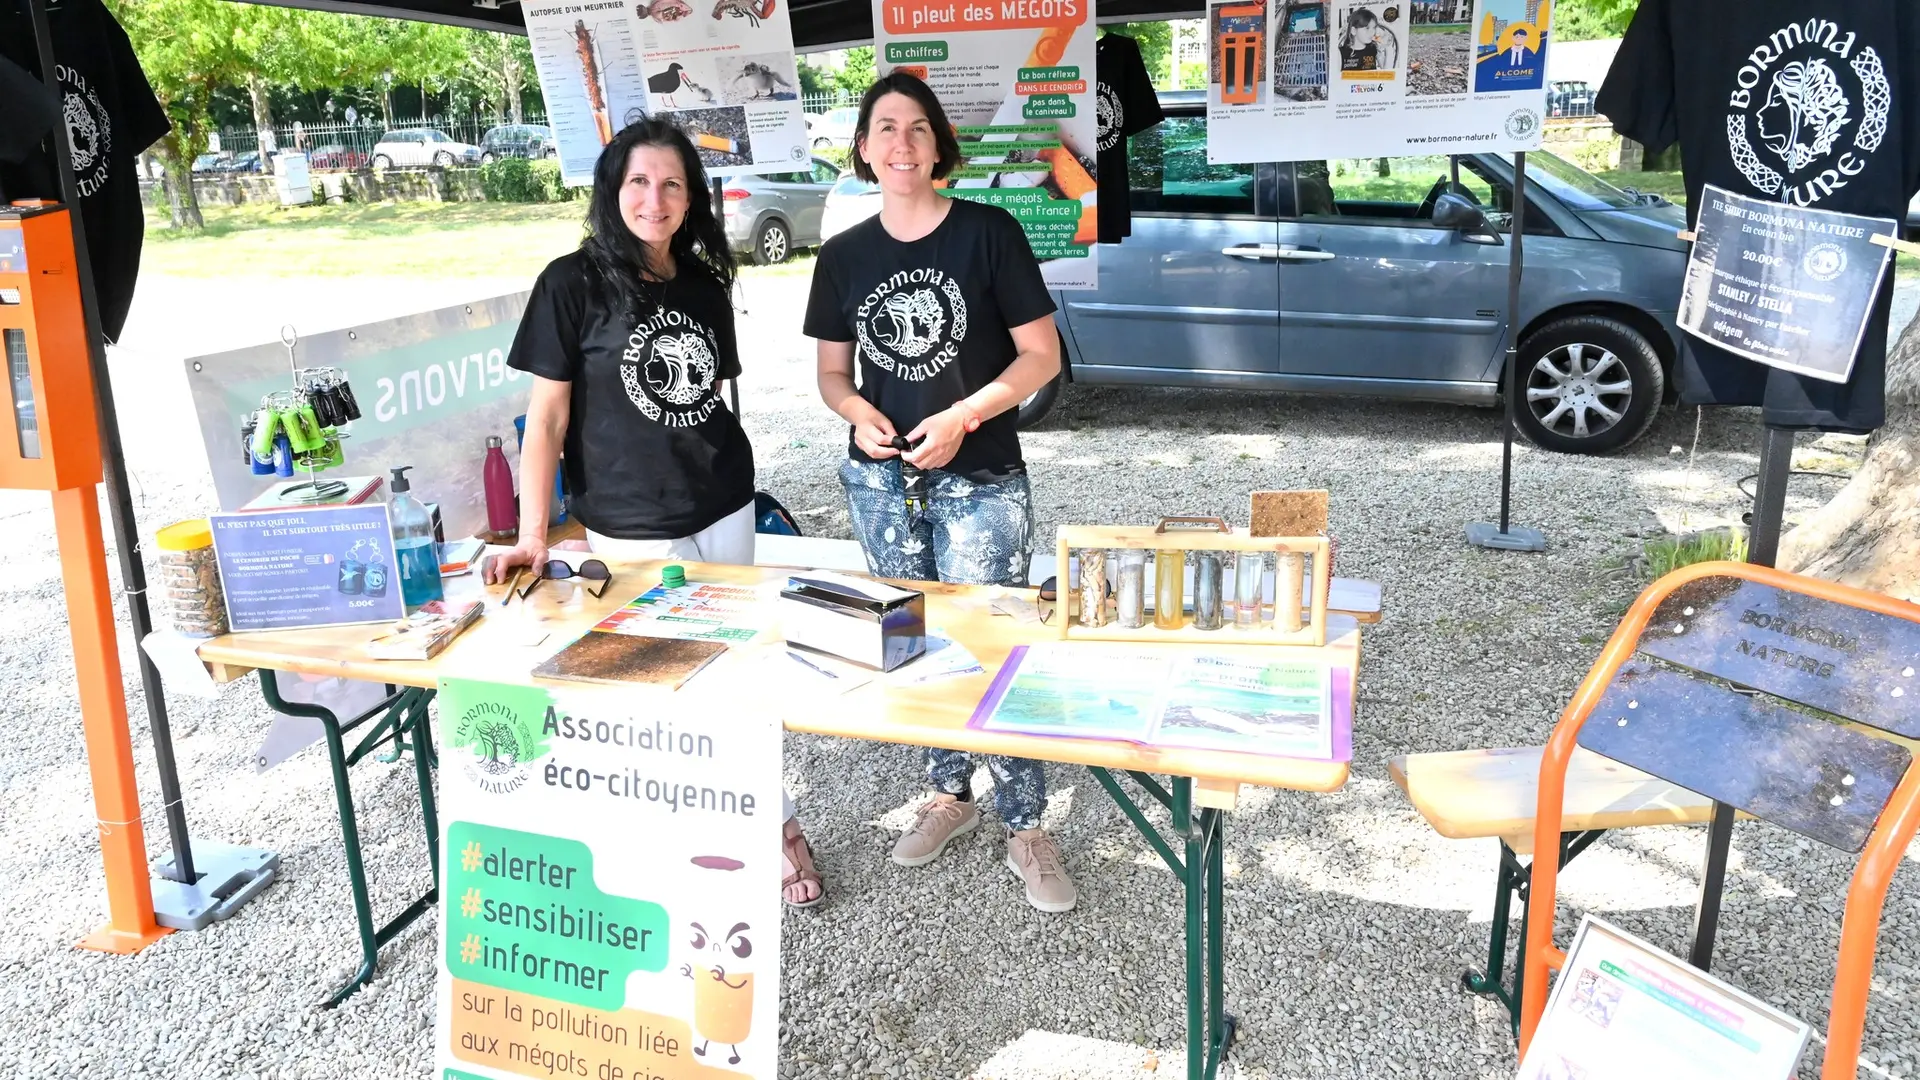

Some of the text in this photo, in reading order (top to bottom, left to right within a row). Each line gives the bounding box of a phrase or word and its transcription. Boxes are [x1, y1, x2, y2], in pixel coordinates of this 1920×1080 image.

[530, 1, 624, 17] AUTOPSIE D'UN MEURTRIER
[912, 5, 956, 28] pleut
[963, 3, 994, 21] des
[890, 45, 944, 58] En chiffres
[1021, 70, 1076, 80] Le bon réflexe
[1494, 68, 1534, 77] ALCOME
[1018, 84, 1038, 92] DANS
[1049, 82, 1084, 91] CENDRIER
[1360, 85, 1375, 93] LYON
[1032, 97, 1066, 107] pas dans
[1026, 107, 1033, 115] le
[1035, 107, 1068, 115] caniveau
[1406, 132, 1498, 144] www.bormona-nature.fr
[990, 193, 1003, 203] de
[1005, 193, 1043, 205] mégots
[1020, 207, 1033, 216] en
[1036, 205, 1070, 216] France
[1712, 199, 1865, 239] TEE SHIRT BORMONA NATURE
[1034, 223, 1047, 231] des
[1048, 223, 1076, 231] déchets
[1741, 223, 1795, 242] En coton bio
[1050, 248, 1063, 256] des
[1742, 249, 1783, 268] 20.00€
[1735, 274, 1760, 288] éthique
[1717, 283, 1751, 304] STANLEY
[1757, 296, 1793, 315] STELLA
[1742, 313, 1765, 326] Nancy
[227, 520, 248, 529] N'EST
[249, 520, 267, 528] PAS
[267, 518, 285, 529] QUE
[273, 528, 288, 536] EST
[288, 526, 328, 536] SURTOUT
[330, 522, 351, 532] TRÈS
[352, 522, 376, 531] UTILE
[268, 562, 294, 570] NATURE
[348, 599, 375, 608] 5.00€
[1739, 608, 1858, 654] BORMONA
[1735, 638, 1836, 679] NATURE
[542, 705, 714, 759] Association
[544, 757, 757, 817] éco-citoyenne
[461, 841, 577, 890] #alerter
[460, 887, 653, 952] #sensibiliser
[460, 933, 610, 992] #informer
[462, 992, 679, 1058] sur la pollution liée
[461, 1031, 499, 1056] aux
[509, 1041, 589, 1076] mégots
[598, 1058, 624, 1080] de
